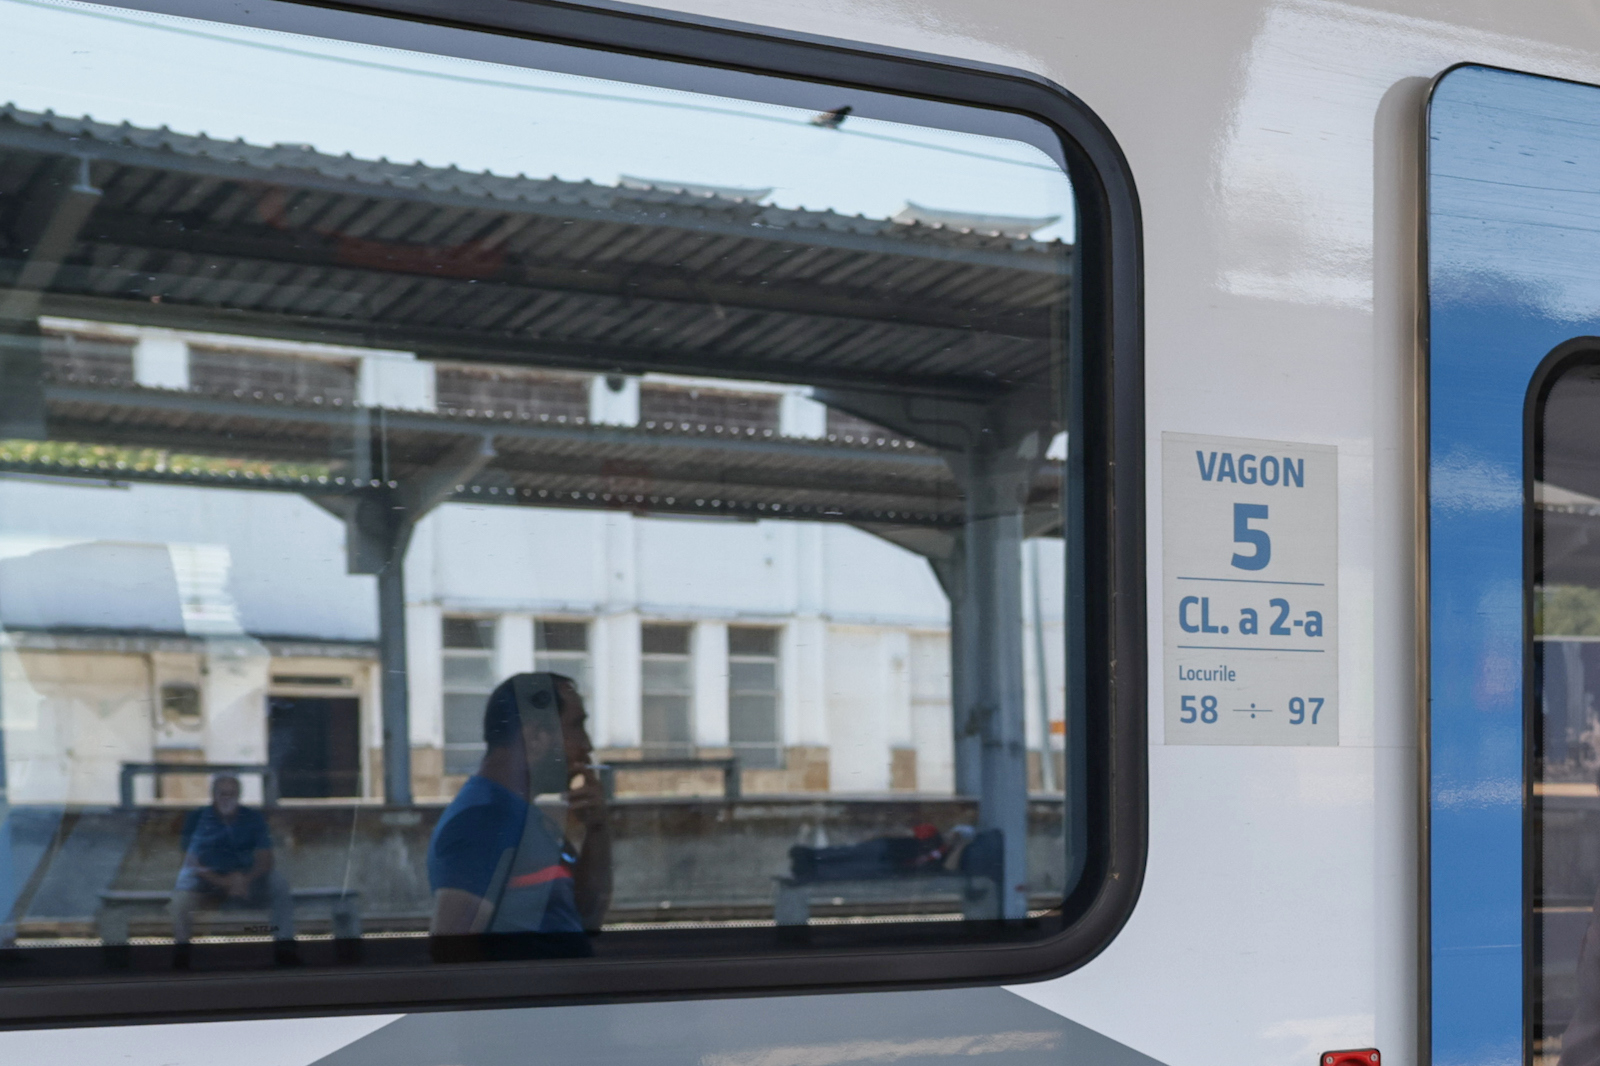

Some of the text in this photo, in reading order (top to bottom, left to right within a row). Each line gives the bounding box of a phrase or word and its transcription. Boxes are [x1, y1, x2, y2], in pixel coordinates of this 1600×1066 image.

[1196, 450, 1305, 488] VAGON
[1230, 502, 1272, 571] 5
[1178, 595, 1324, 637] CL. a 2-a
[1178, 665, 1236, 682] Locurile
[1179, 694, 1218, 725] 58
[1288, 697, 1325, 725] 97
